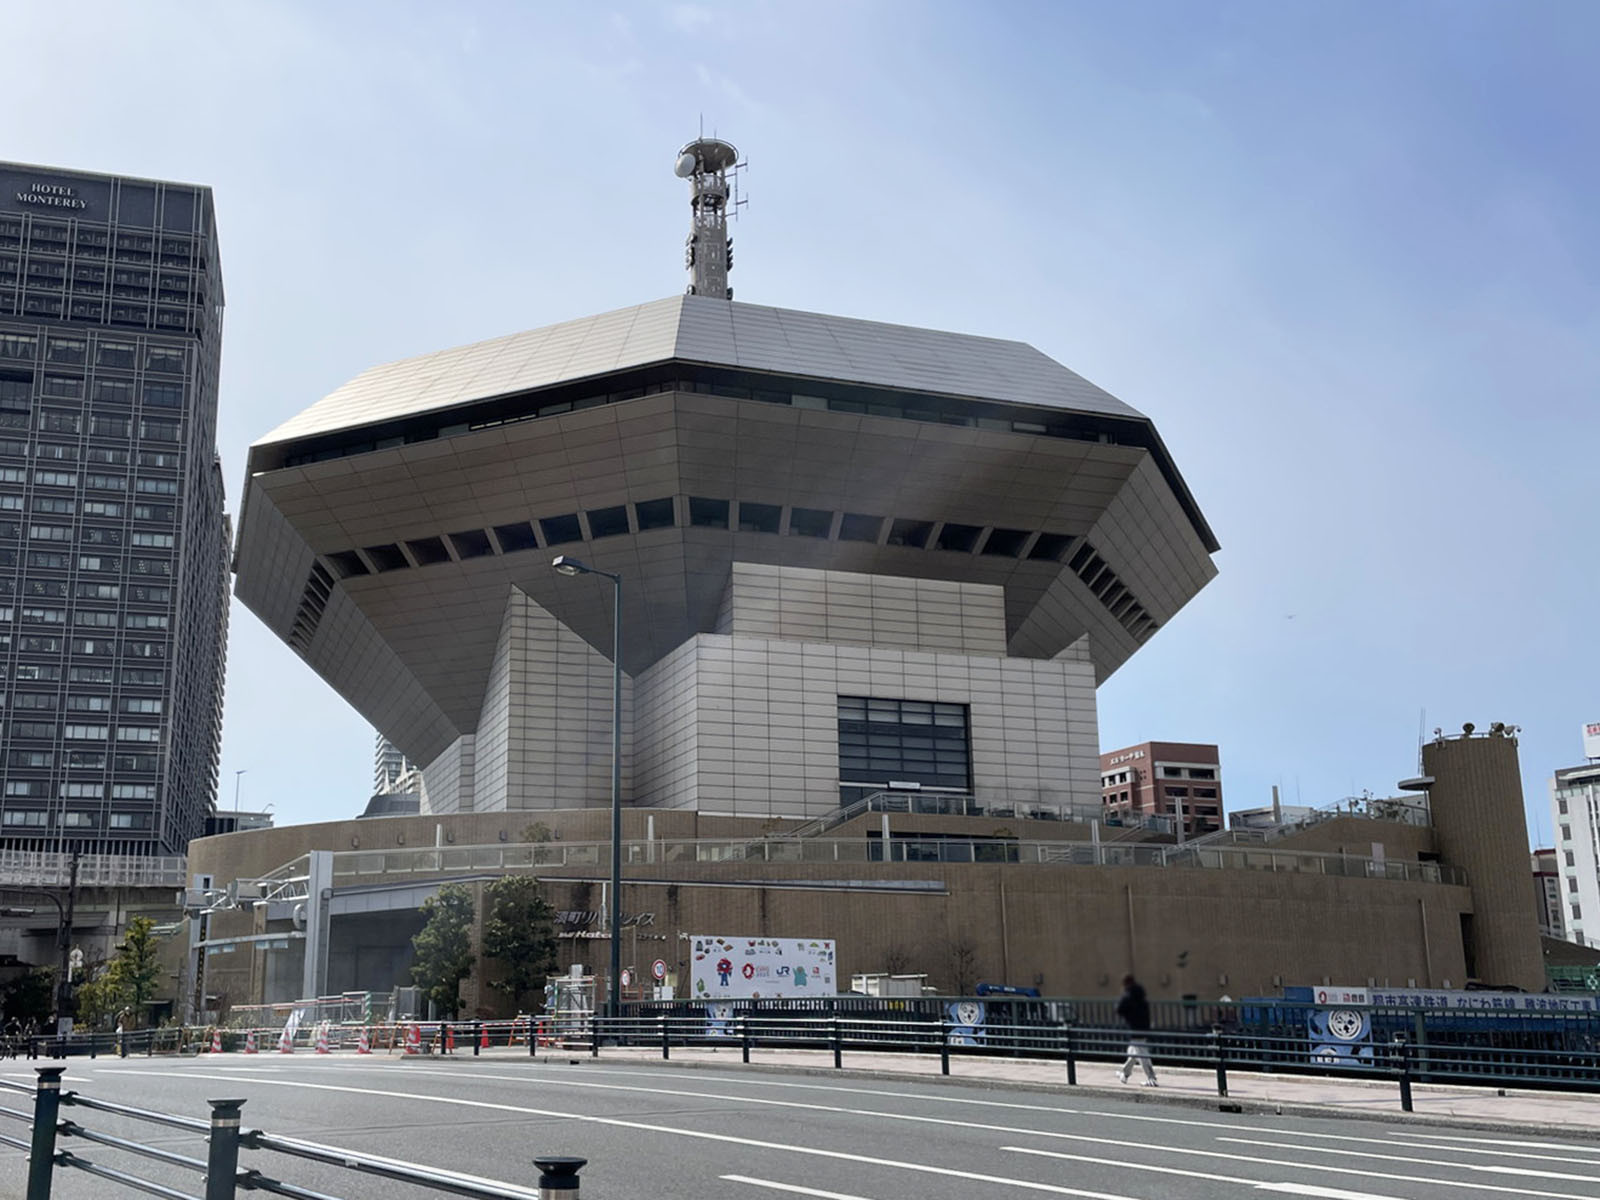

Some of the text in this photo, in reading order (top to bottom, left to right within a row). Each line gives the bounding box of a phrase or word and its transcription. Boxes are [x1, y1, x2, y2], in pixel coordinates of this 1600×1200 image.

[32, 183, 75, 196] HOTEL
[16, 192, 88, 209] MONTEREY
[776, 966, 790, 976] JR
